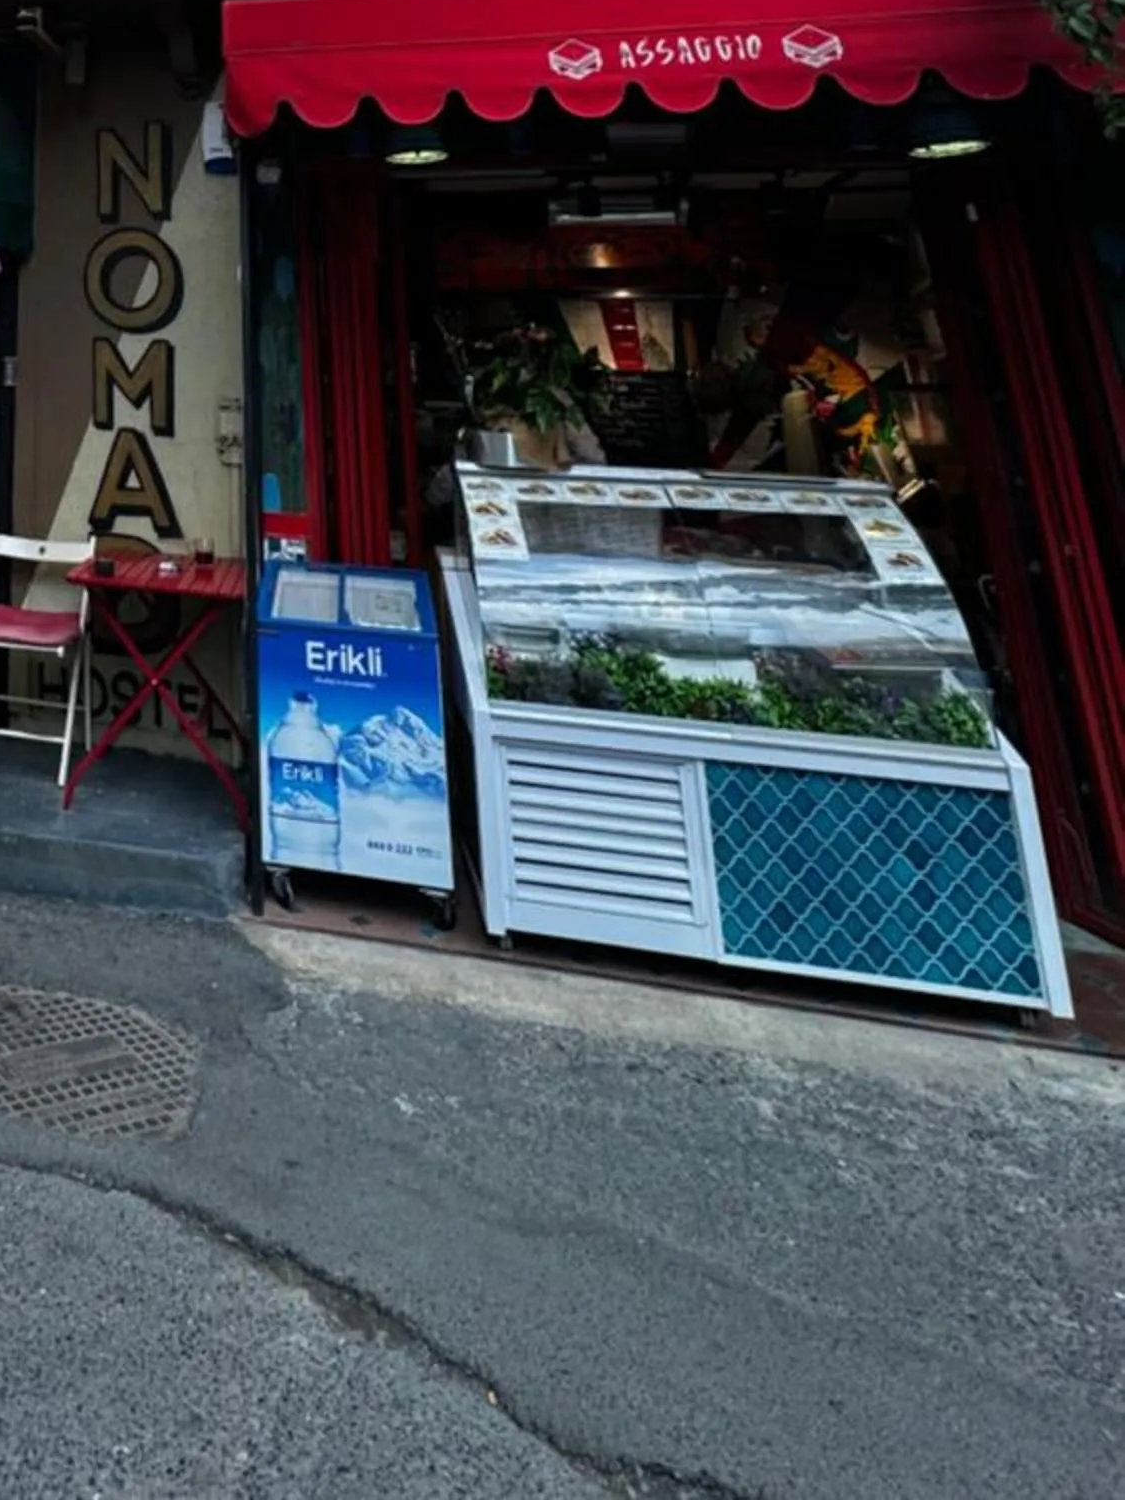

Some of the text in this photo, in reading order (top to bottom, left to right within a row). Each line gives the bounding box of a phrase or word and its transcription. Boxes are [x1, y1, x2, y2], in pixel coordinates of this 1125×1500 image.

[619, 33, 762, 69] ASSAGGIO
[84, 119, 183, 656] NOMAD
[305, 640, 382, 676] Erikli
[282, 762, 324, 783] Erikli
